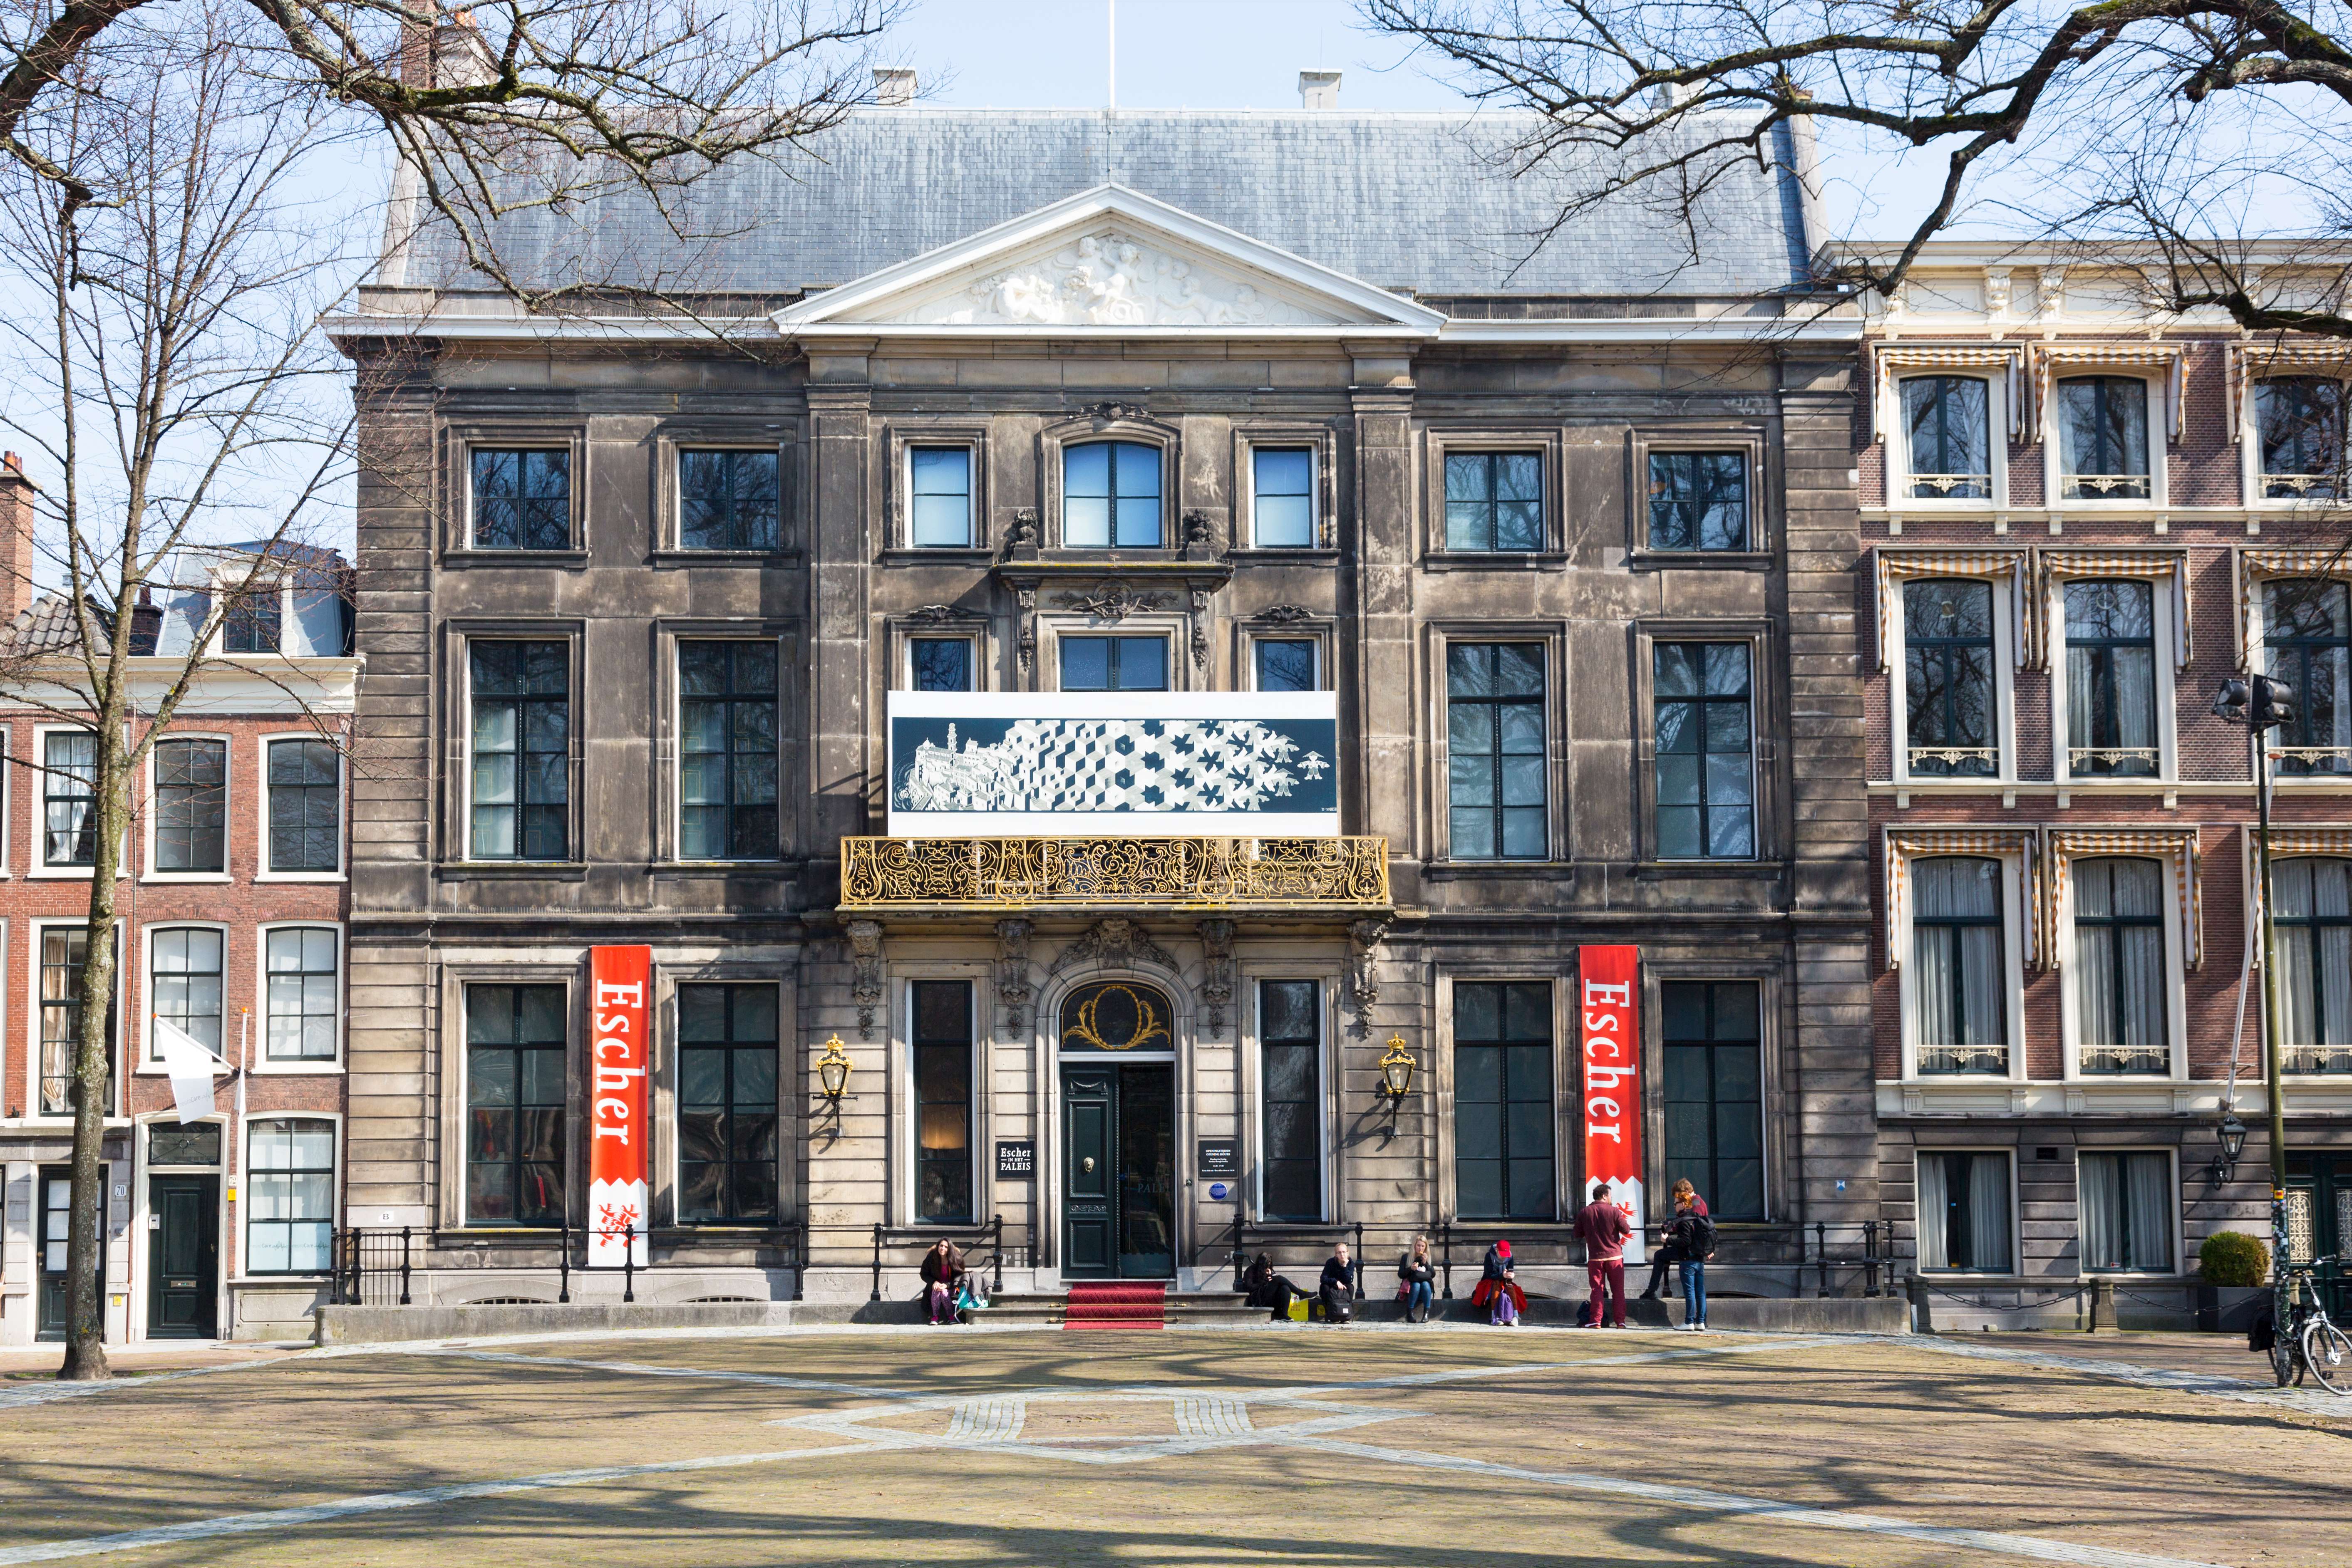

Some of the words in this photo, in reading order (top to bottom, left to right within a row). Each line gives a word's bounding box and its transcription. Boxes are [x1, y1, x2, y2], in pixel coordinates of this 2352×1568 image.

[595, 979, 645, 1145] Escher
[1585, 978, 1635, 1144] Escher
[117, 1186, 124, 1195] 70
[1000, 1147, 1031, 1157] Escher
